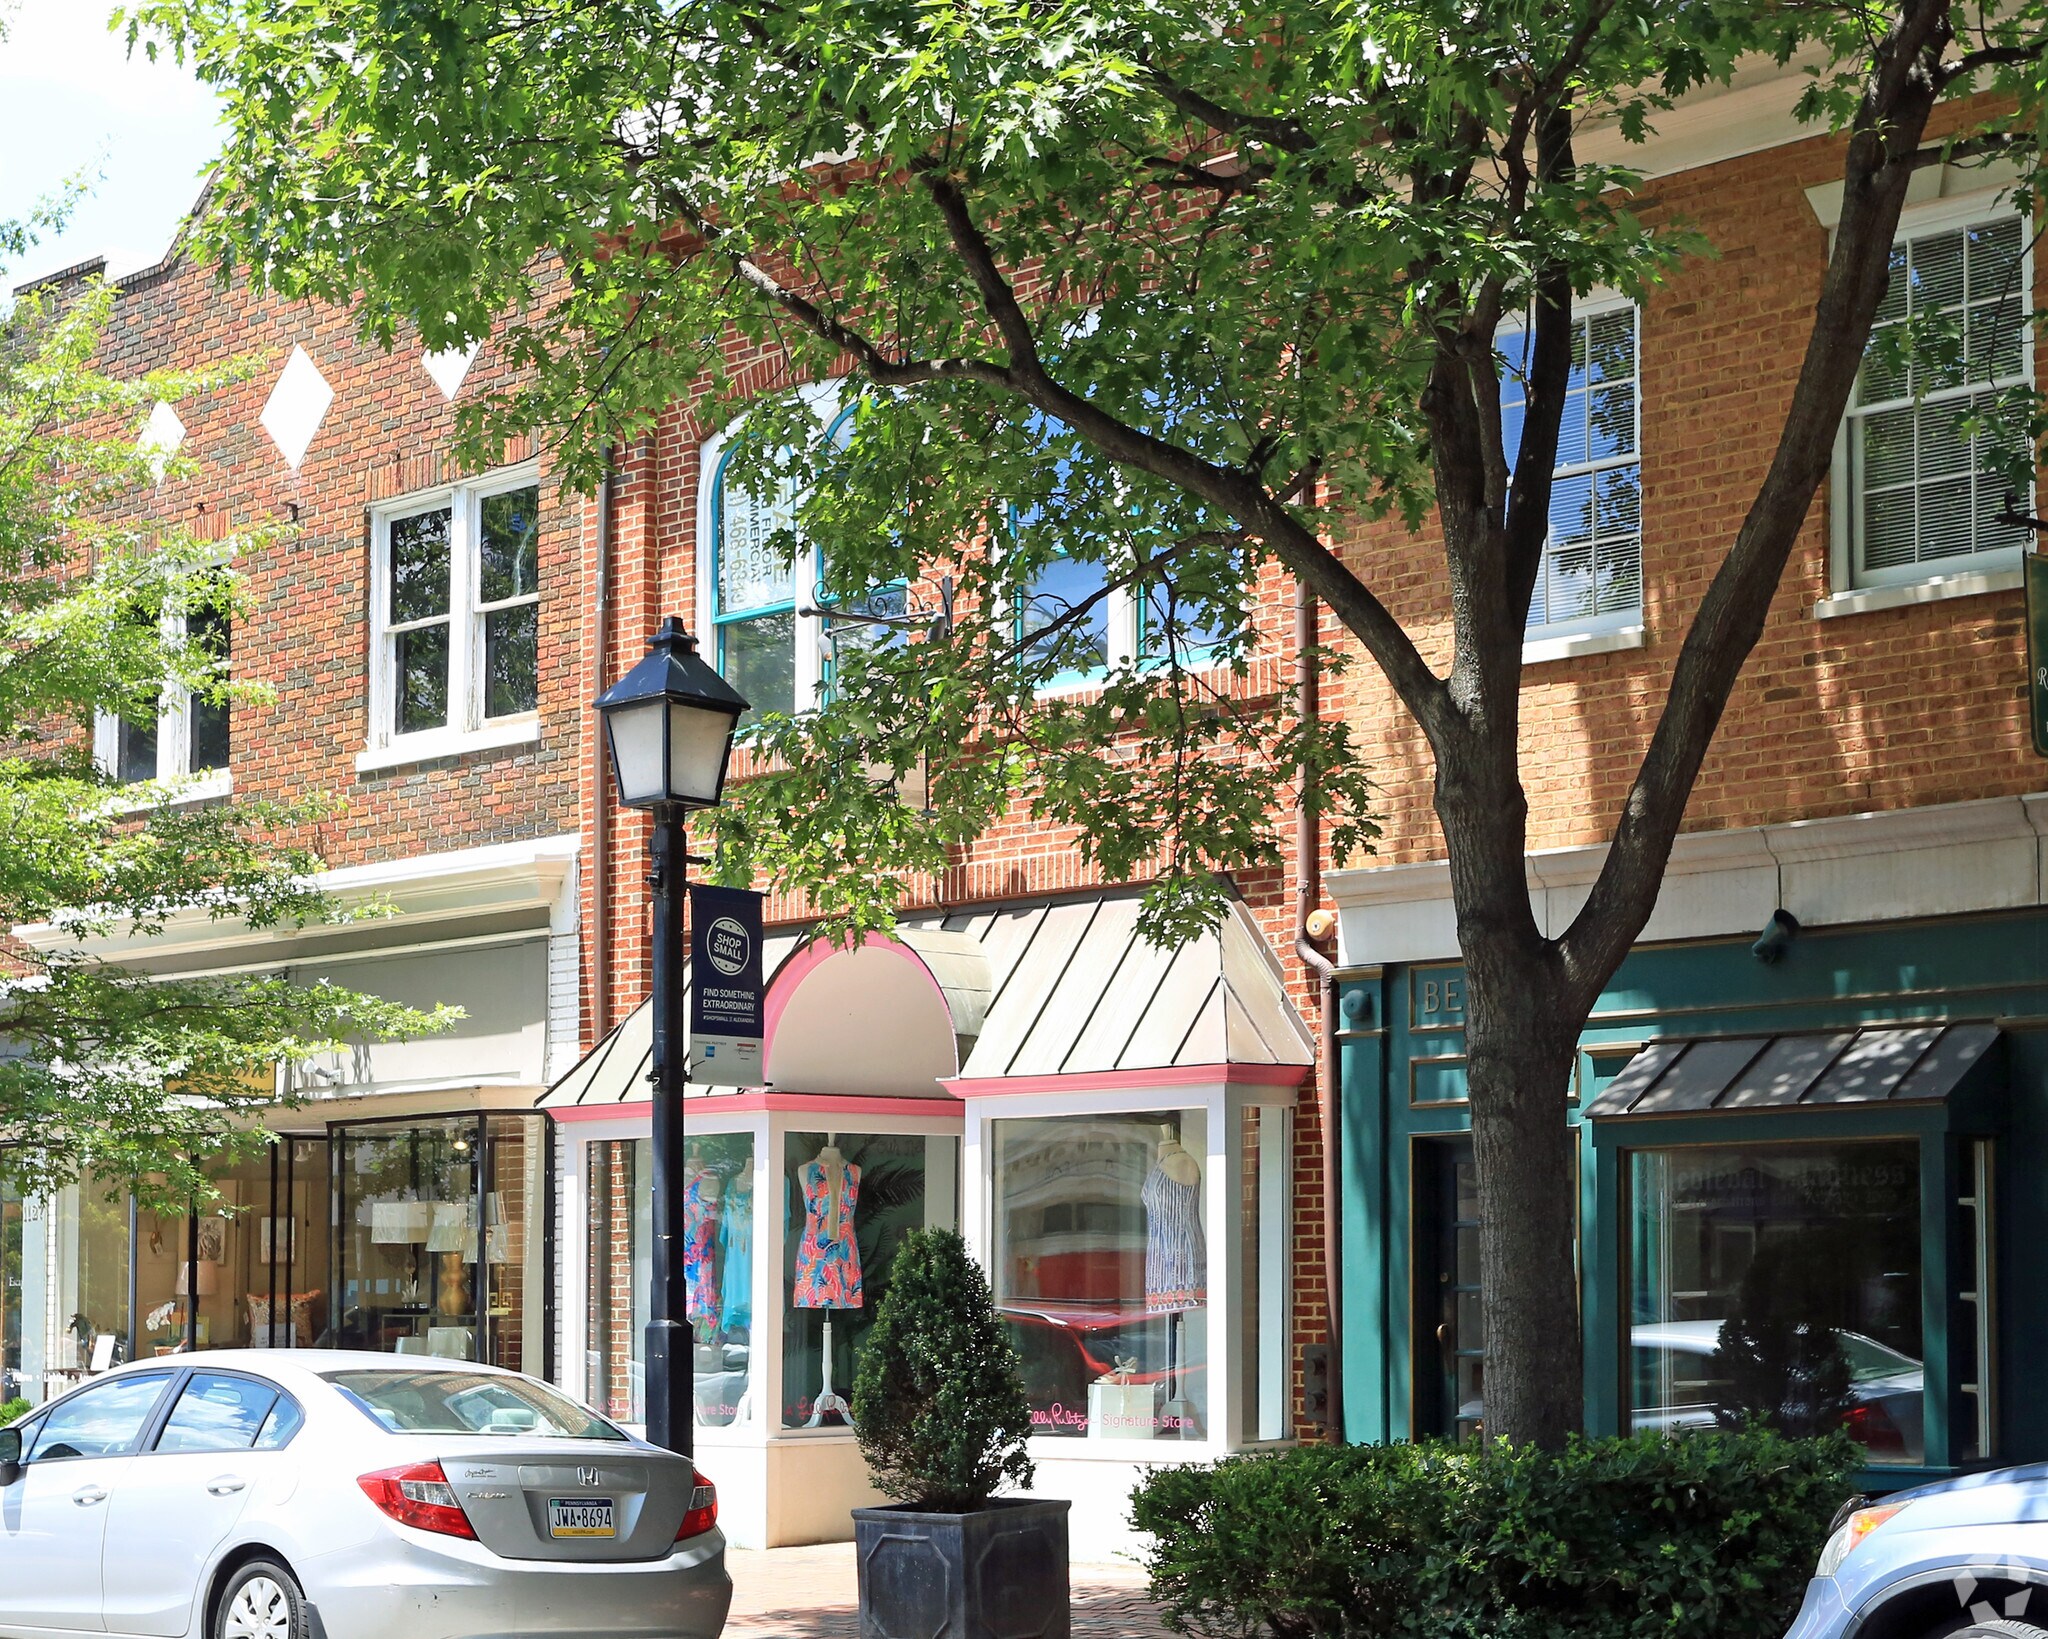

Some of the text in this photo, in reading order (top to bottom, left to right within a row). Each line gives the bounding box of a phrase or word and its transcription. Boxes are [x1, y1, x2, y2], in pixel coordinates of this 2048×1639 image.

[717, 933, 742, 949] SHOP
[713, 942, 742, 961] SMALL
[703, 988, 755, 1000] FIND SOMETHING
[703, 999, 755, 1011] EXTRAORDINARY
[1103, 1413, 1159, 1429] Signature
[1161, 1415, 1194, 1429] Store
